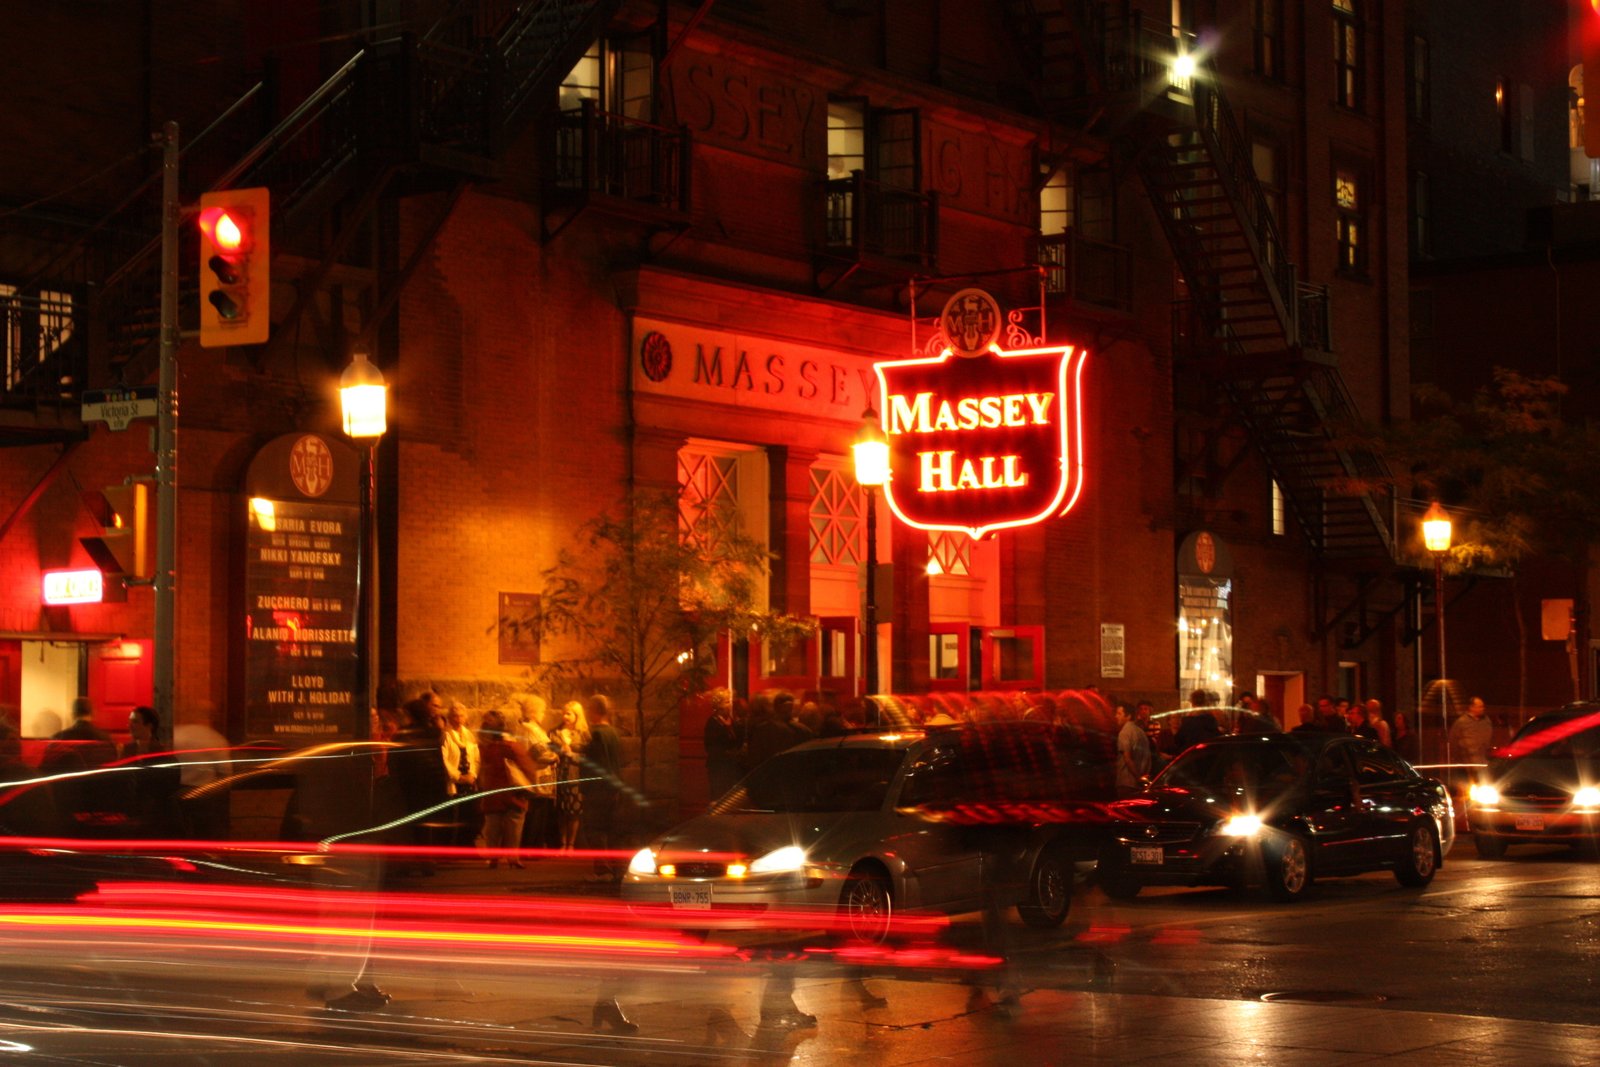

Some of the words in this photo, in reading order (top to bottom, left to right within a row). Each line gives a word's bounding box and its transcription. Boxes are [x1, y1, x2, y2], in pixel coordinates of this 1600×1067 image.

[693, 343, 877, 408] MASSEY
[100, 404, 129, 418] Victoria
[131, 402, 138, 416] St
[888, 391, 1055, 434] MASSEY
[917, 450, 1027, 492] HALL
[276, 518, 305, 532] SARIA
[310, 520, 342, 534] EVORA
[260, 548, 288, 562] NIKKI
[290, 550, 341, 566] YANOFSKY
[257, 595, 309, 610] ZUCCHERO
[292, 675, 324, 688] LLOYD
[268, 690, 294, 703] WITH
[309, 691, 352, 704] HOLIDAY
